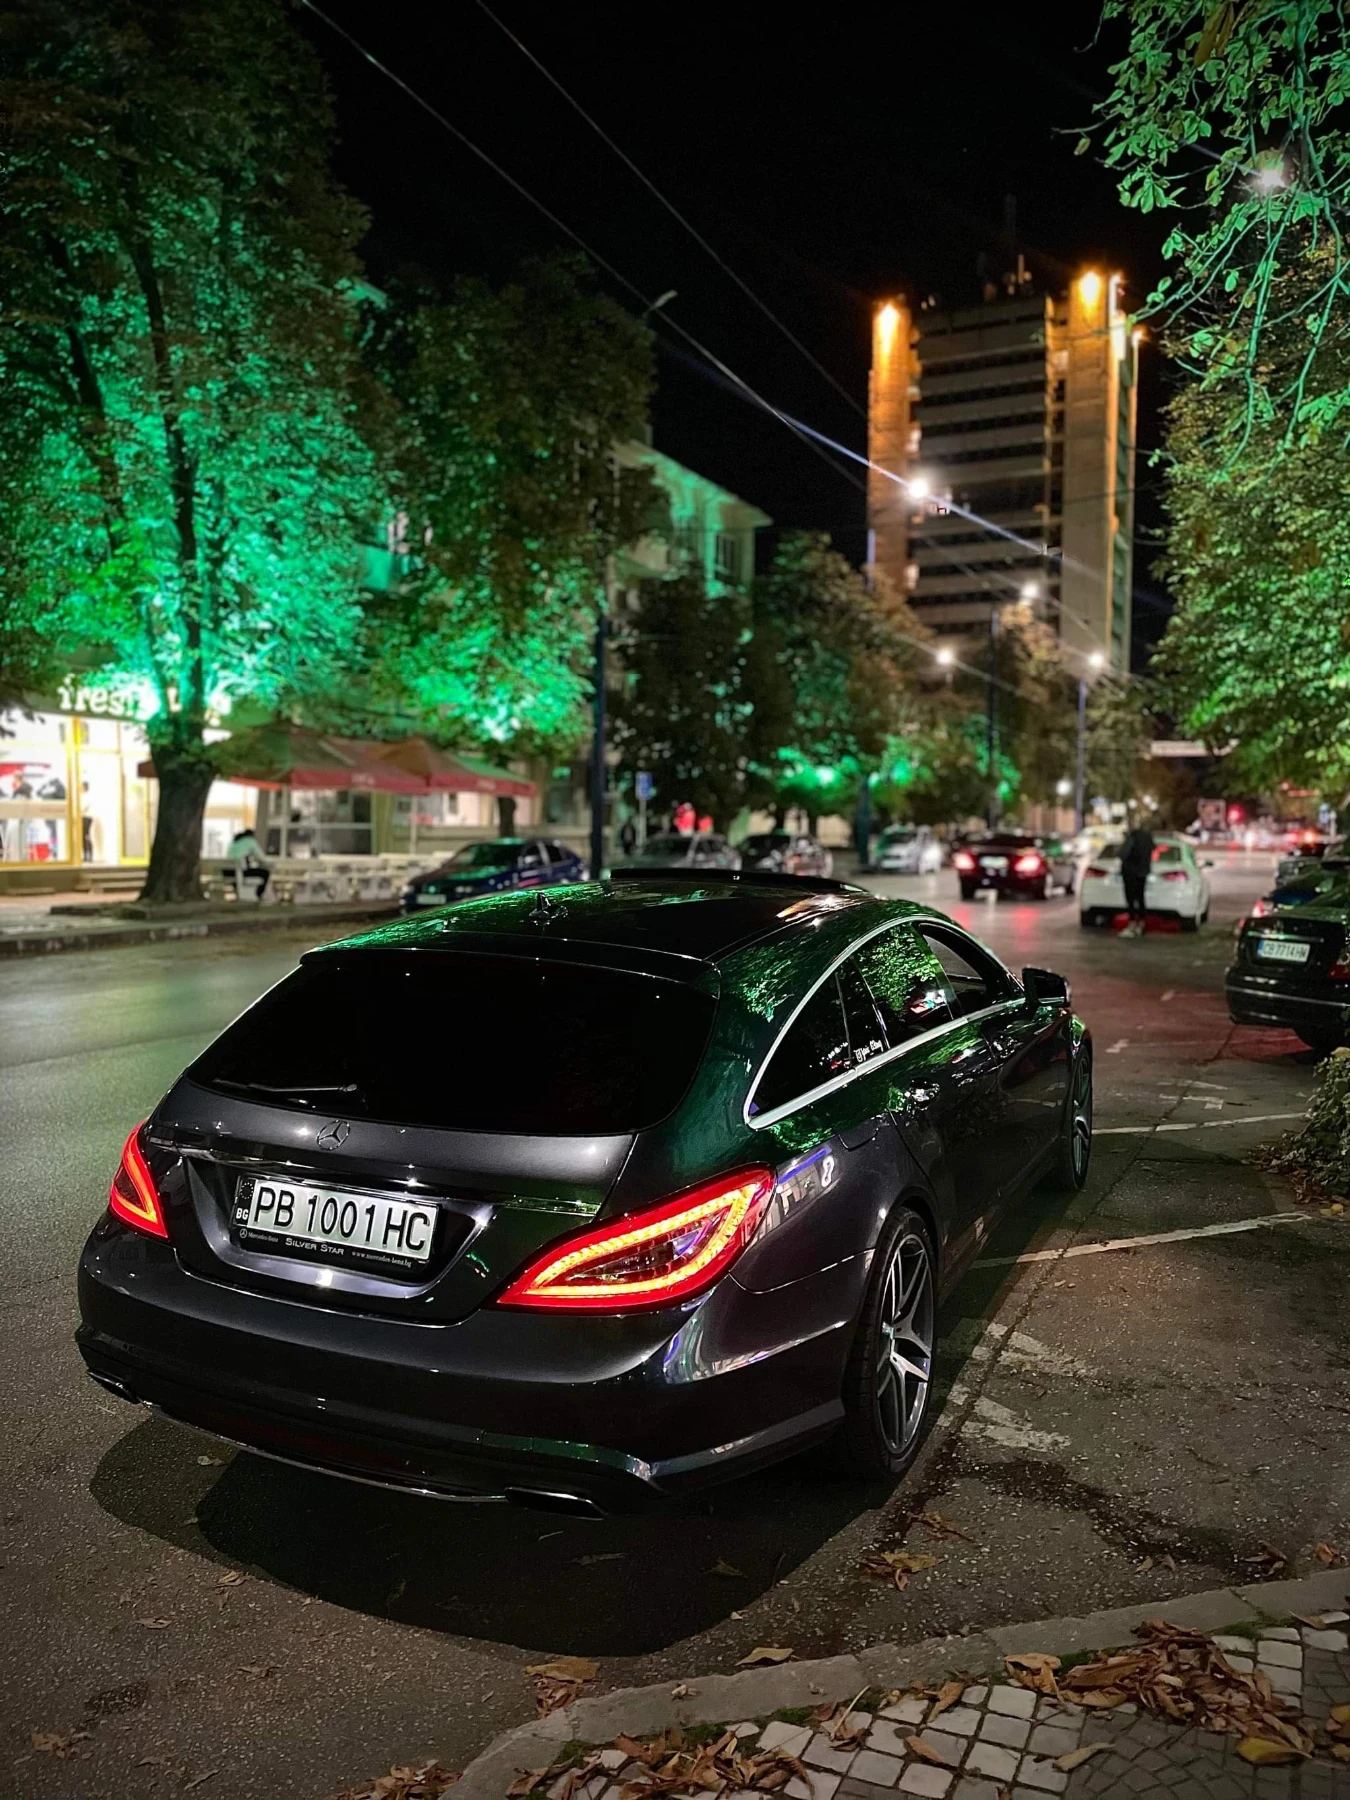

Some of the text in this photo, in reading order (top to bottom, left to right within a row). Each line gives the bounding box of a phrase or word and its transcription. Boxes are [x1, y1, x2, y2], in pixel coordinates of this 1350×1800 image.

[235, 1207, 249, 1220] BG
[253, 1186, 430, 1251] PB 1001 HC
